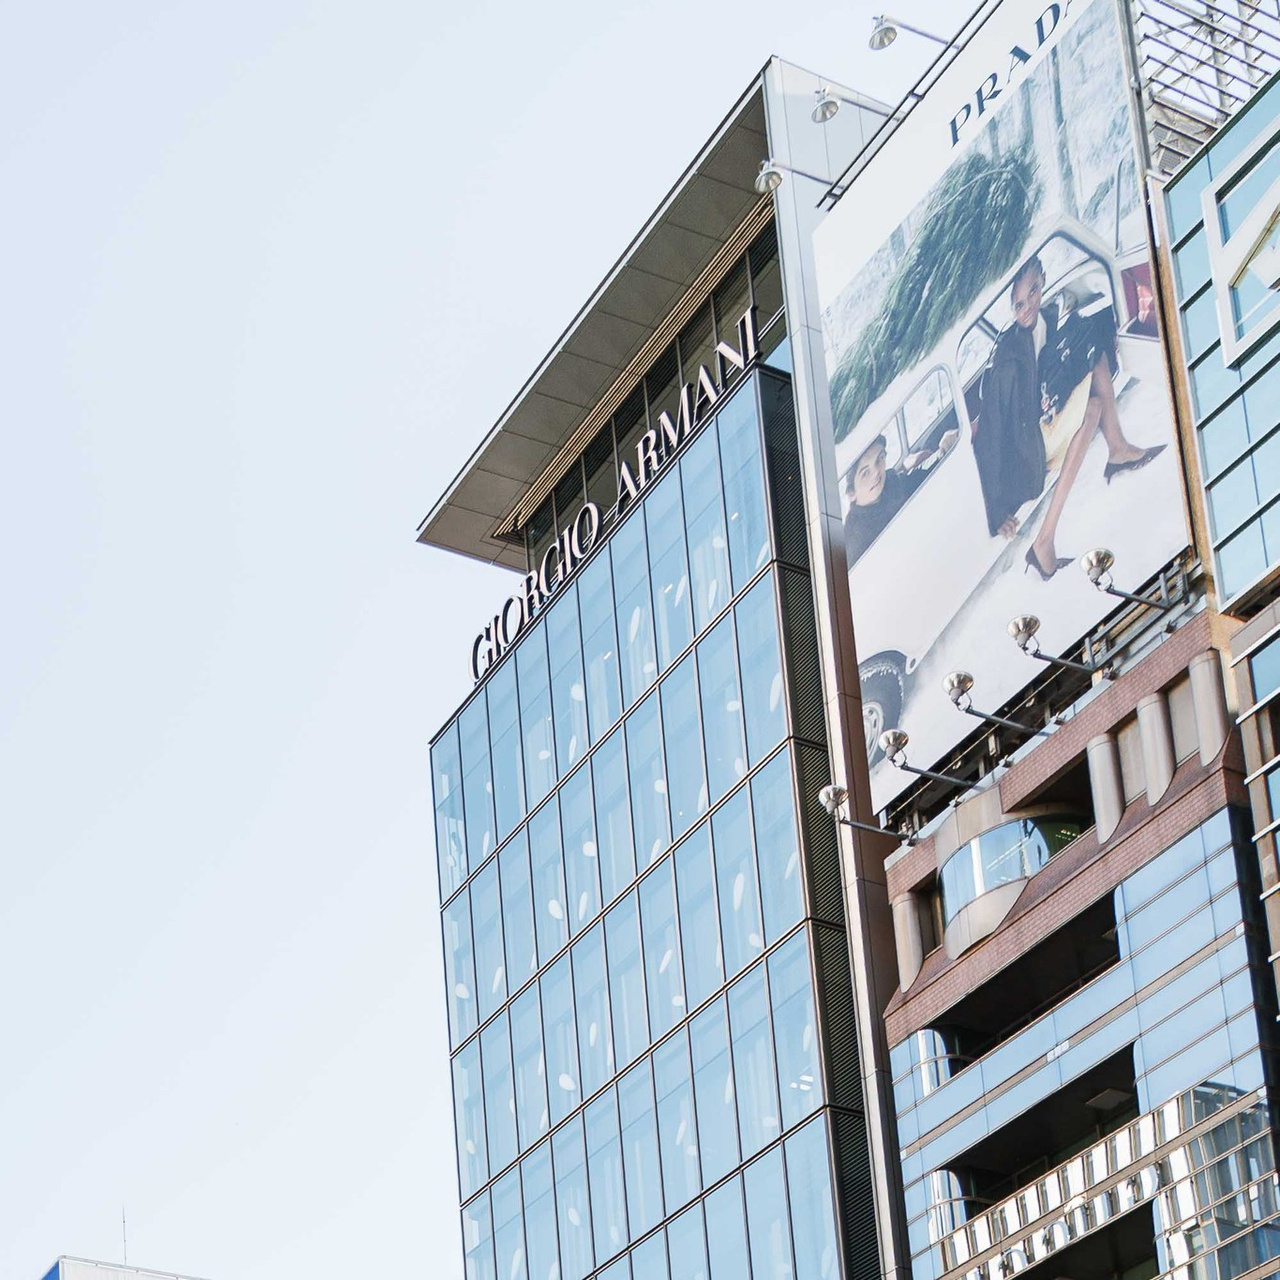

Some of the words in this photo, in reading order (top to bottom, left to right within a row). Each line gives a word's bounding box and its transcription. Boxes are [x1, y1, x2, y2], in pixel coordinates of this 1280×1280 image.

[949, 0, 1071, 148] PRAD
[469, 502, 604, 685] GIORGIO
[613, 305, 761, 517] ARMANI
